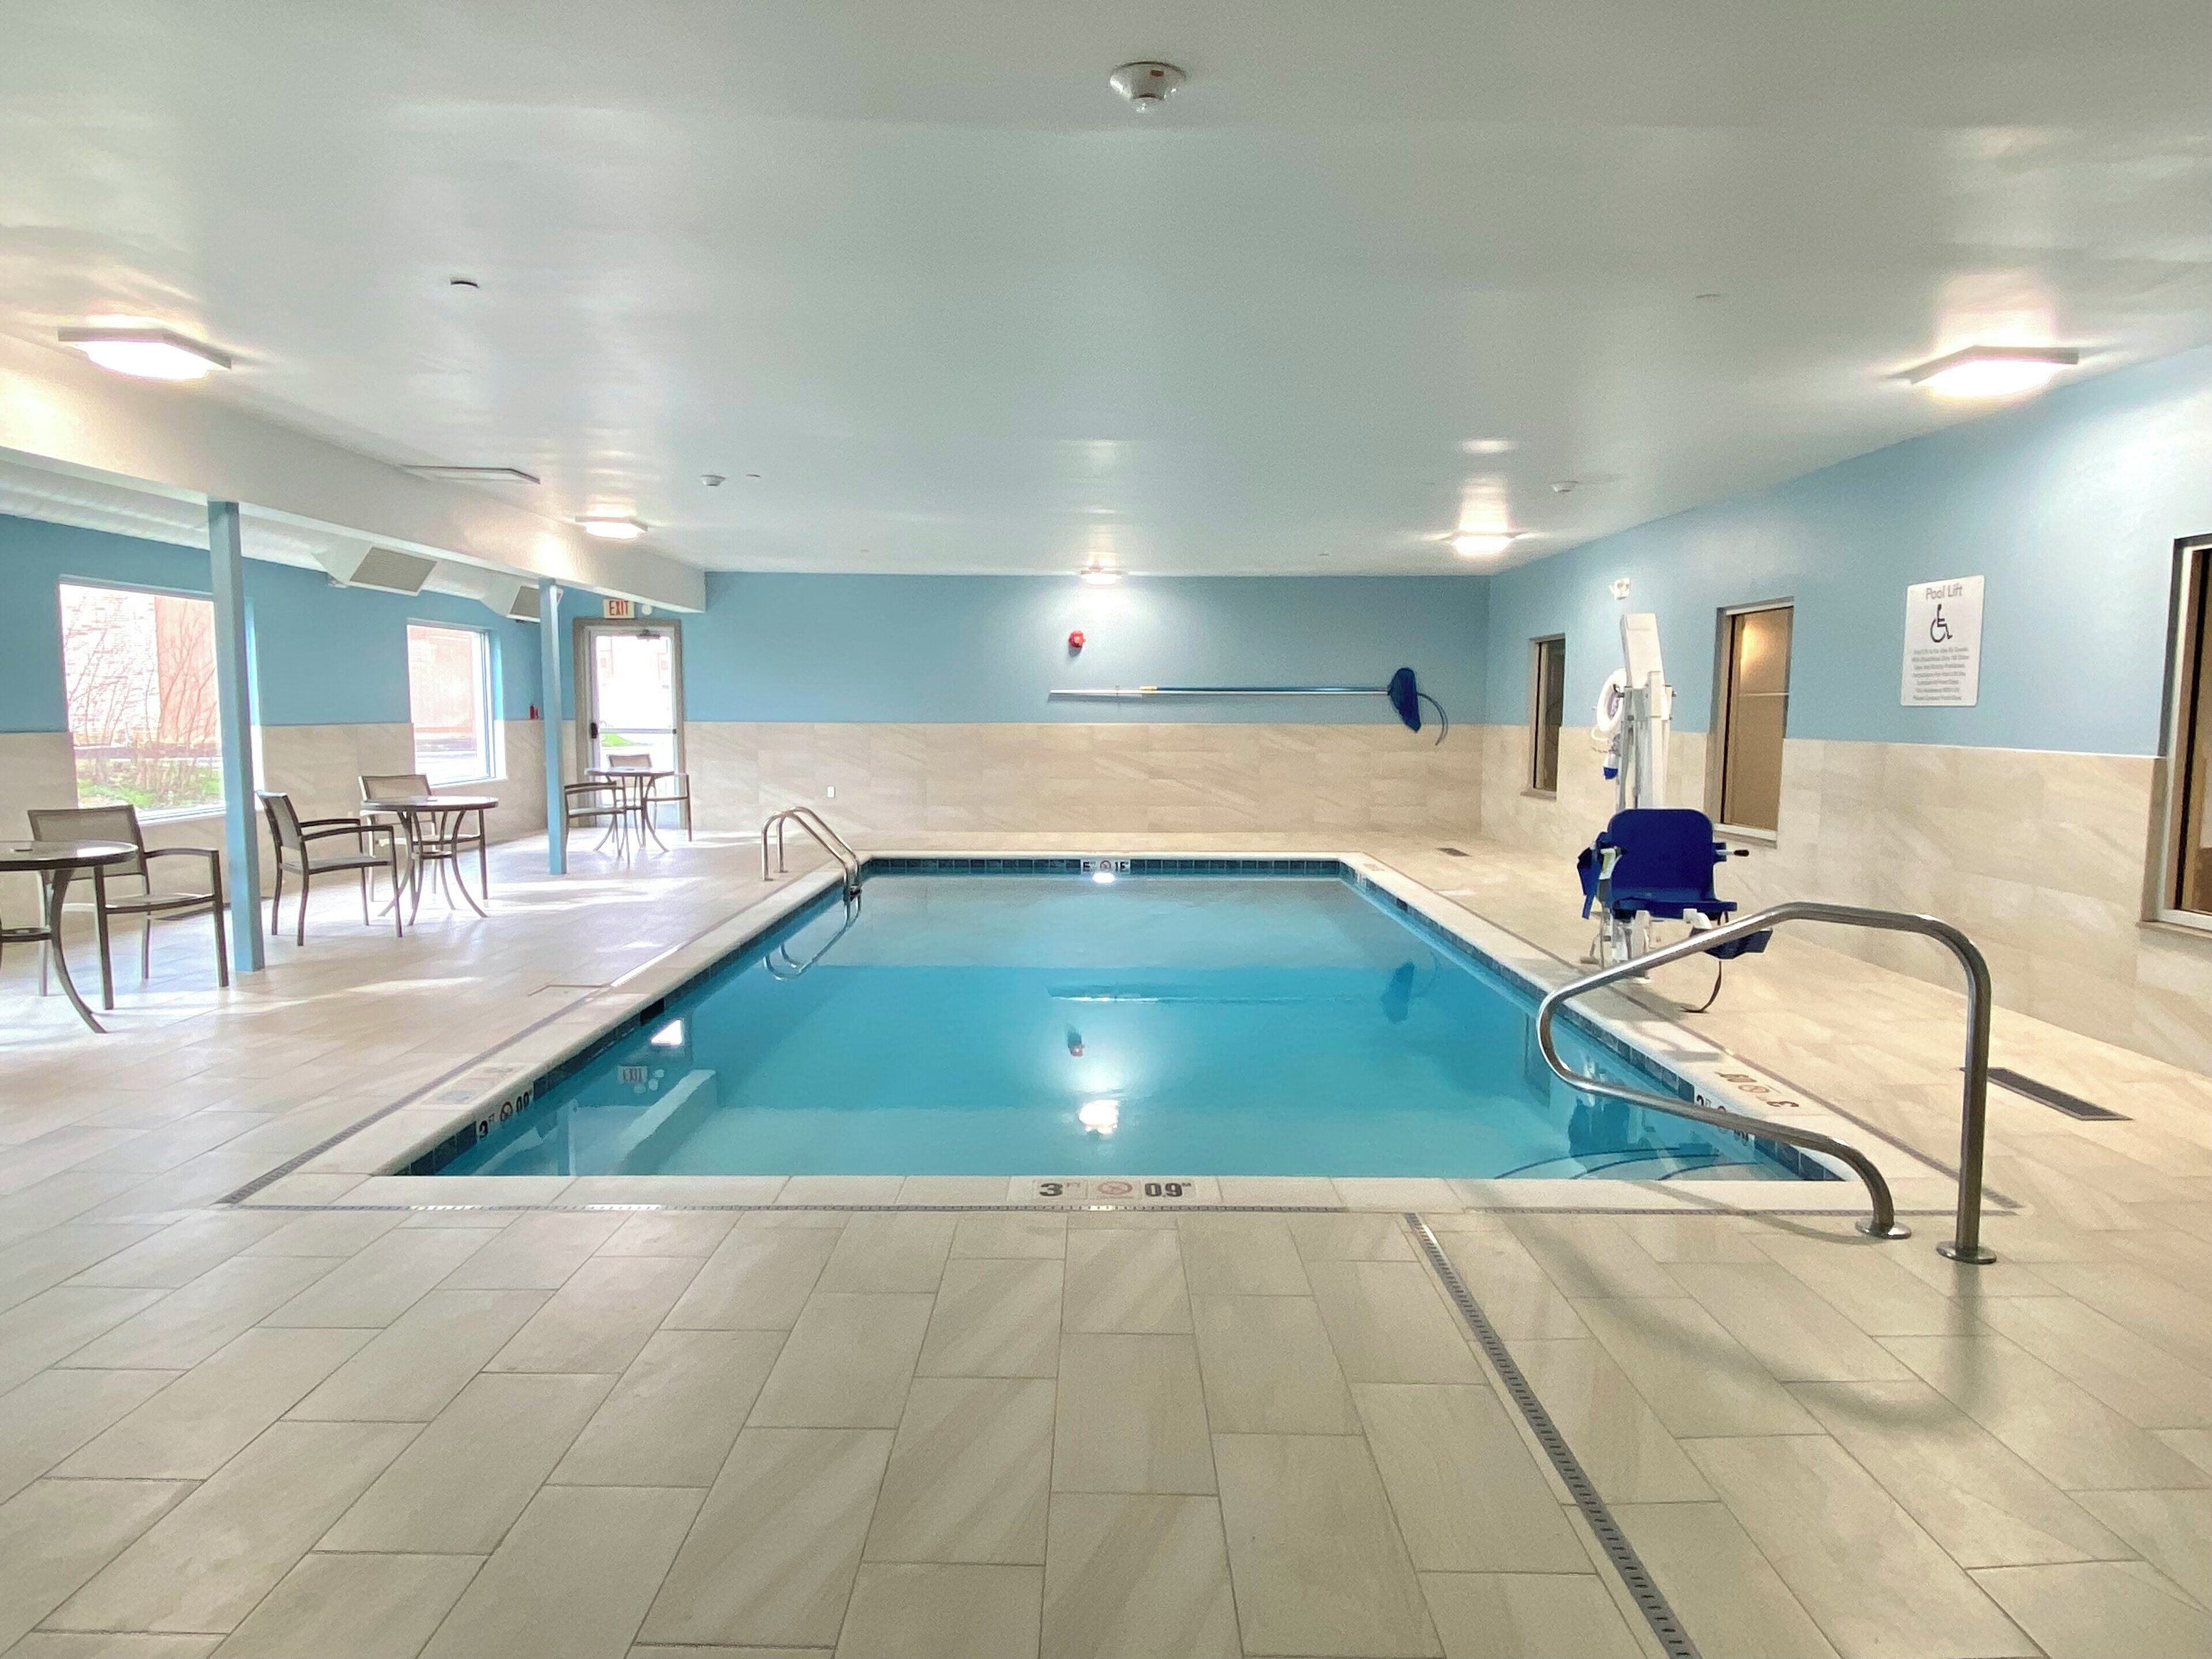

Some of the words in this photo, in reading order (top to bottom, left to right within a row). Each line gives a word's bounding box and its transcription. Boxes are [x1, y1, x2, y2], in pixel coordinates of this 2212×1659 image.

[1926, 585, 1945, 600] Pool
[1948, 583, 1963, 597] Lift
[609, 600, 629, 616] EXIT
[1039, 1183, 1063, 1197] 3
